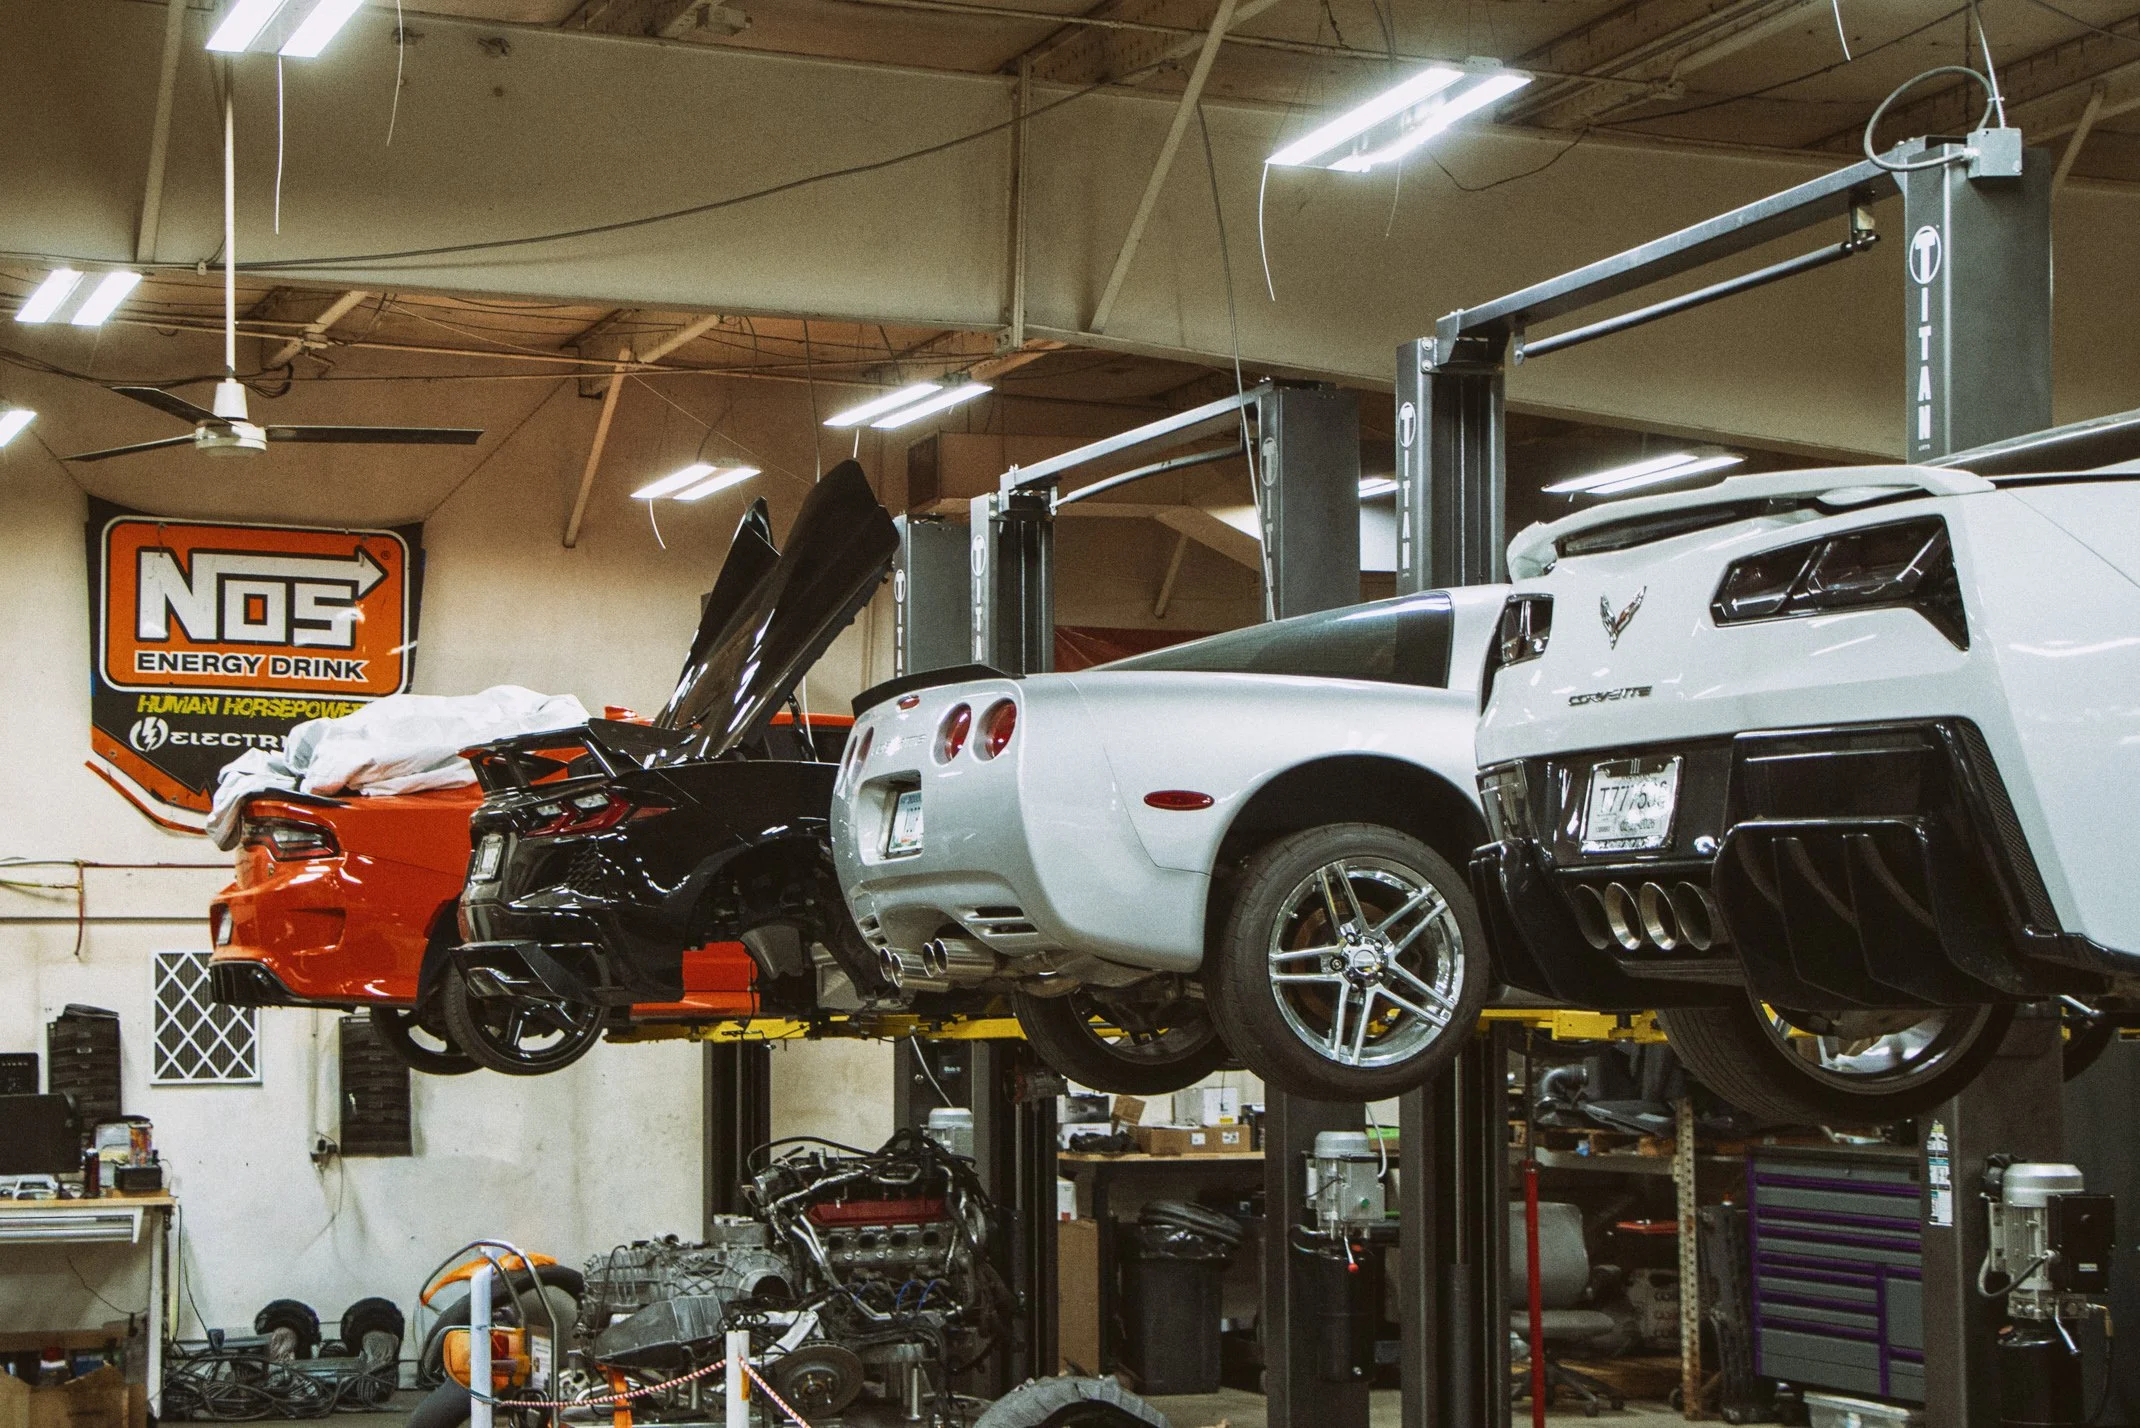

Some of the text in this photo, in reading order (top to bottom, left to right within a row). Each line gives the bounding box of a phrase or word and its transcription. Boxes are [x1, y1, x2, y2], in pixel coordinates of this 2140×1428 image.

[1909, 226, 1941, 440] TITAN
[1399, 402, 1416, 569] TITAN
[136, 547, 357, 651] NOS
[894, 569, 906, 677] TITA
[136, 651, 367, 682] ENERGY DRINK
[137, 694, 219, 715] HUMAN
[1568, 685, 1652, 706] CORVETTE
